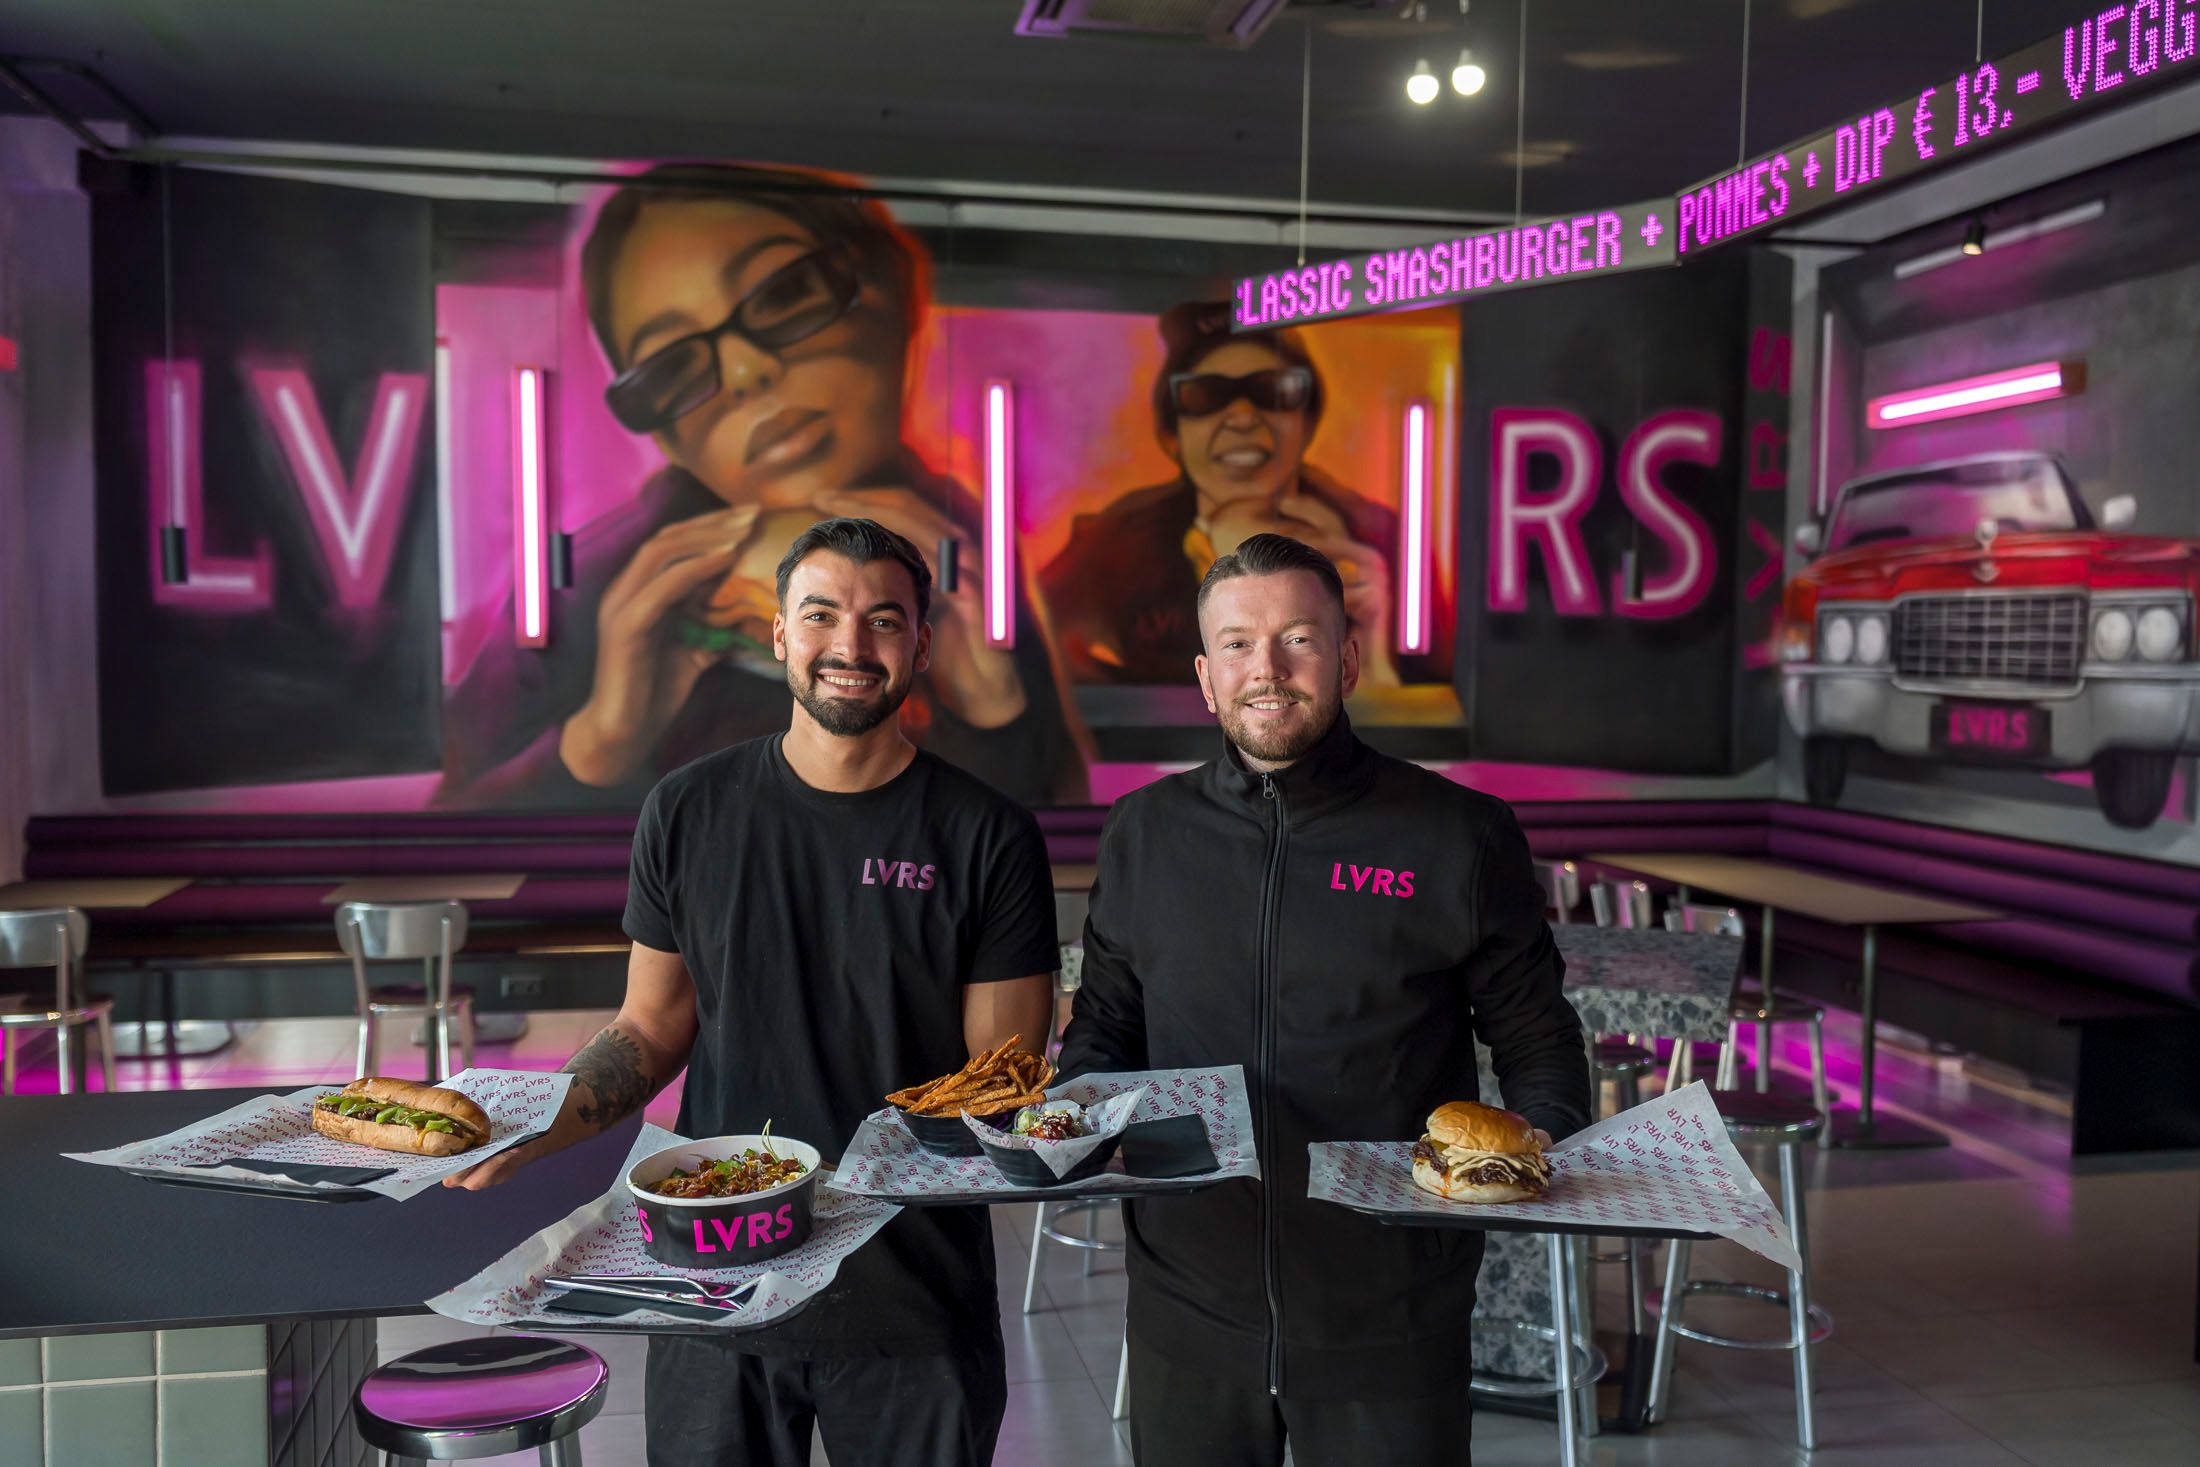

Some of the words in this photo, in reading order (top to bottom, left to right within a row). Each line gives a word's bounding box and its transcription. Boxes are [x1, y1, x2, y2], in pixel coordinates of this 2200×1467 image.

[1236, 260, 1352, 326] LASSIC
[1365, 211, 1621, 305] SMASHBURGER
[1640, 213, 1663, 247] +
[1680, 153, 1789, 253] POMMES
[1803, 151, 1821, 188] +
[1835, 106, 1895, 192] DIP
[1912, 87, 1936, 159] €
[1949, 706, 2028, 748] LVRS
[862, 858, 936, 891] LVRS
[1330, 863, 1415, 898] LVRS
[475, 1075, 499, 1087] LVRS
[500, 1075, 525, 1087] LVRS
[525, 1077, 550, 1088] LVRS
[1109, 1082, 1120, 1092] RS
[1146, 1079, 1163, 1096] LVRS
[1173, 1078, 1184, 1088] RS
[1210, 1073, 1228, 1090] LVRS
[464, 1090, 476, 1098] RS
[477, 1090, 501, 1103] LVRS
[501, 1090, 526, 1101] LVRS
[1084, 1085, 1099, 1100] VRS
[1189, 1081, 1206, 1099] LVRS
[527, 1093, 551, 1104] LVRS
[1167, 1089, 1184, 1106] LVRS
[1210, 1091, 1228, 1107] LVRS
[490, 1104, 502, 1113] RS
[503, 1106, 528, 1118] LVRS
[1146, 1097, 1163, 1115] LVRS
[1167, 1108, 1179, 1116] LV
[251, 1115, 275, 1123] VRS
[1210, 1108, 1228, 1121] LVRS
[1667, 1108, 1687, 1128] LVR
[490, 1120, 503, 1128] RS
[504, 1122, 529, 1134] LVRS
[1643, 1120, 1667, 1144] LVRS
[1624, 1137, 1646, 1157] LVRS
[1671, 1130, 1695, 1151] LVRS
[1699, 1139, 1716, 1154] RS
[1602, 1151, 1624, 1166] LVRS
[1651, 1146, 1673, 1163] LVRS
[1557, 1159, 1571, 1170] RS
[1580, 1152, 1601, 1171] LVRS
[693, 1204, 793, 1253] LVRS
[853, 1221, 873, 1231] LVR
[596, 1228, 617, 1240] VRS
[586, 1241, 614, 1249] LVRS
[611, 1246, 640, 1254] LVRS
[608, 1256, 636, 1264] LVRS
[772, 1263, 800, 1272] LVRS
[529, 1275, 543, 1289] RS
[800, 1269, 820, 1282] VRS
[807, 1281, 820, 1290] RS
